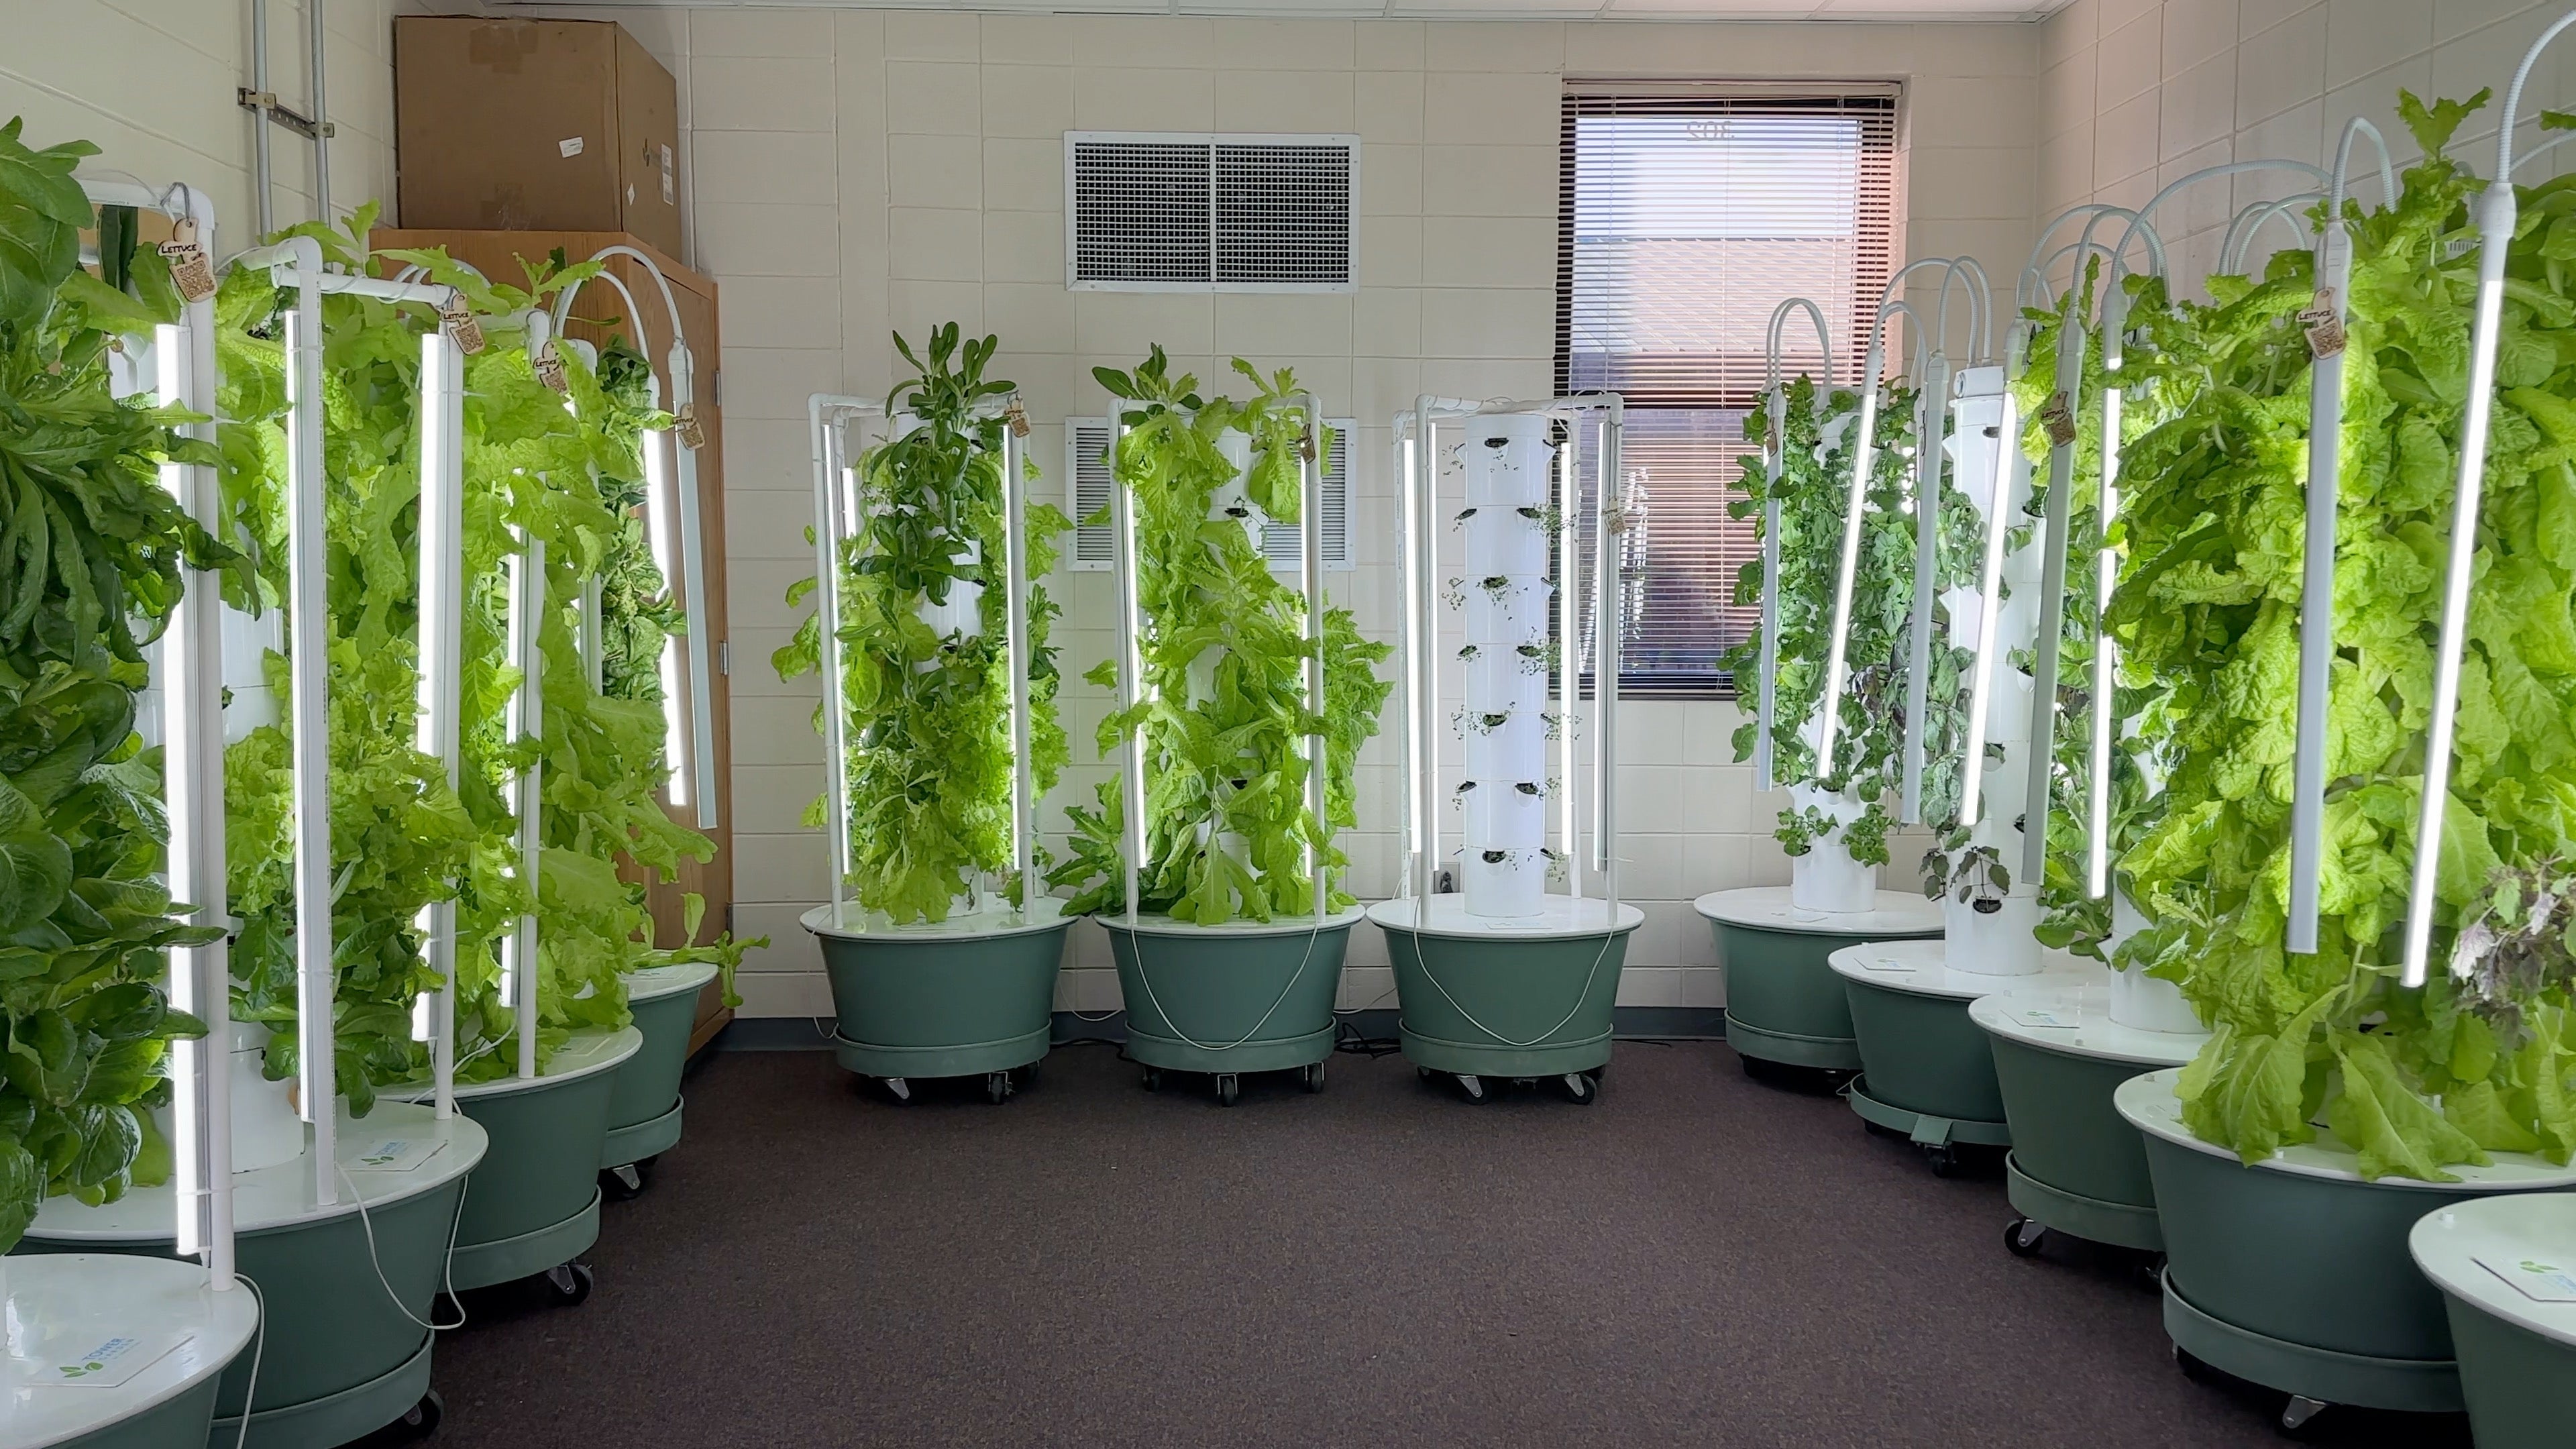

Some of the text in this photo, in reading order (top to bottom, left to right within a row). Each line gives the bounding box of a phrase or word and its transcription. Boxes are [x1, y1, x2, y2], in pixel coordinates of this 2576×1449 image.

[161, 244, 197, 254] LETTUCE
[2298, 310, 2331, 320] LETTUCE
[535, 359, 557, 368] LETTUCE
